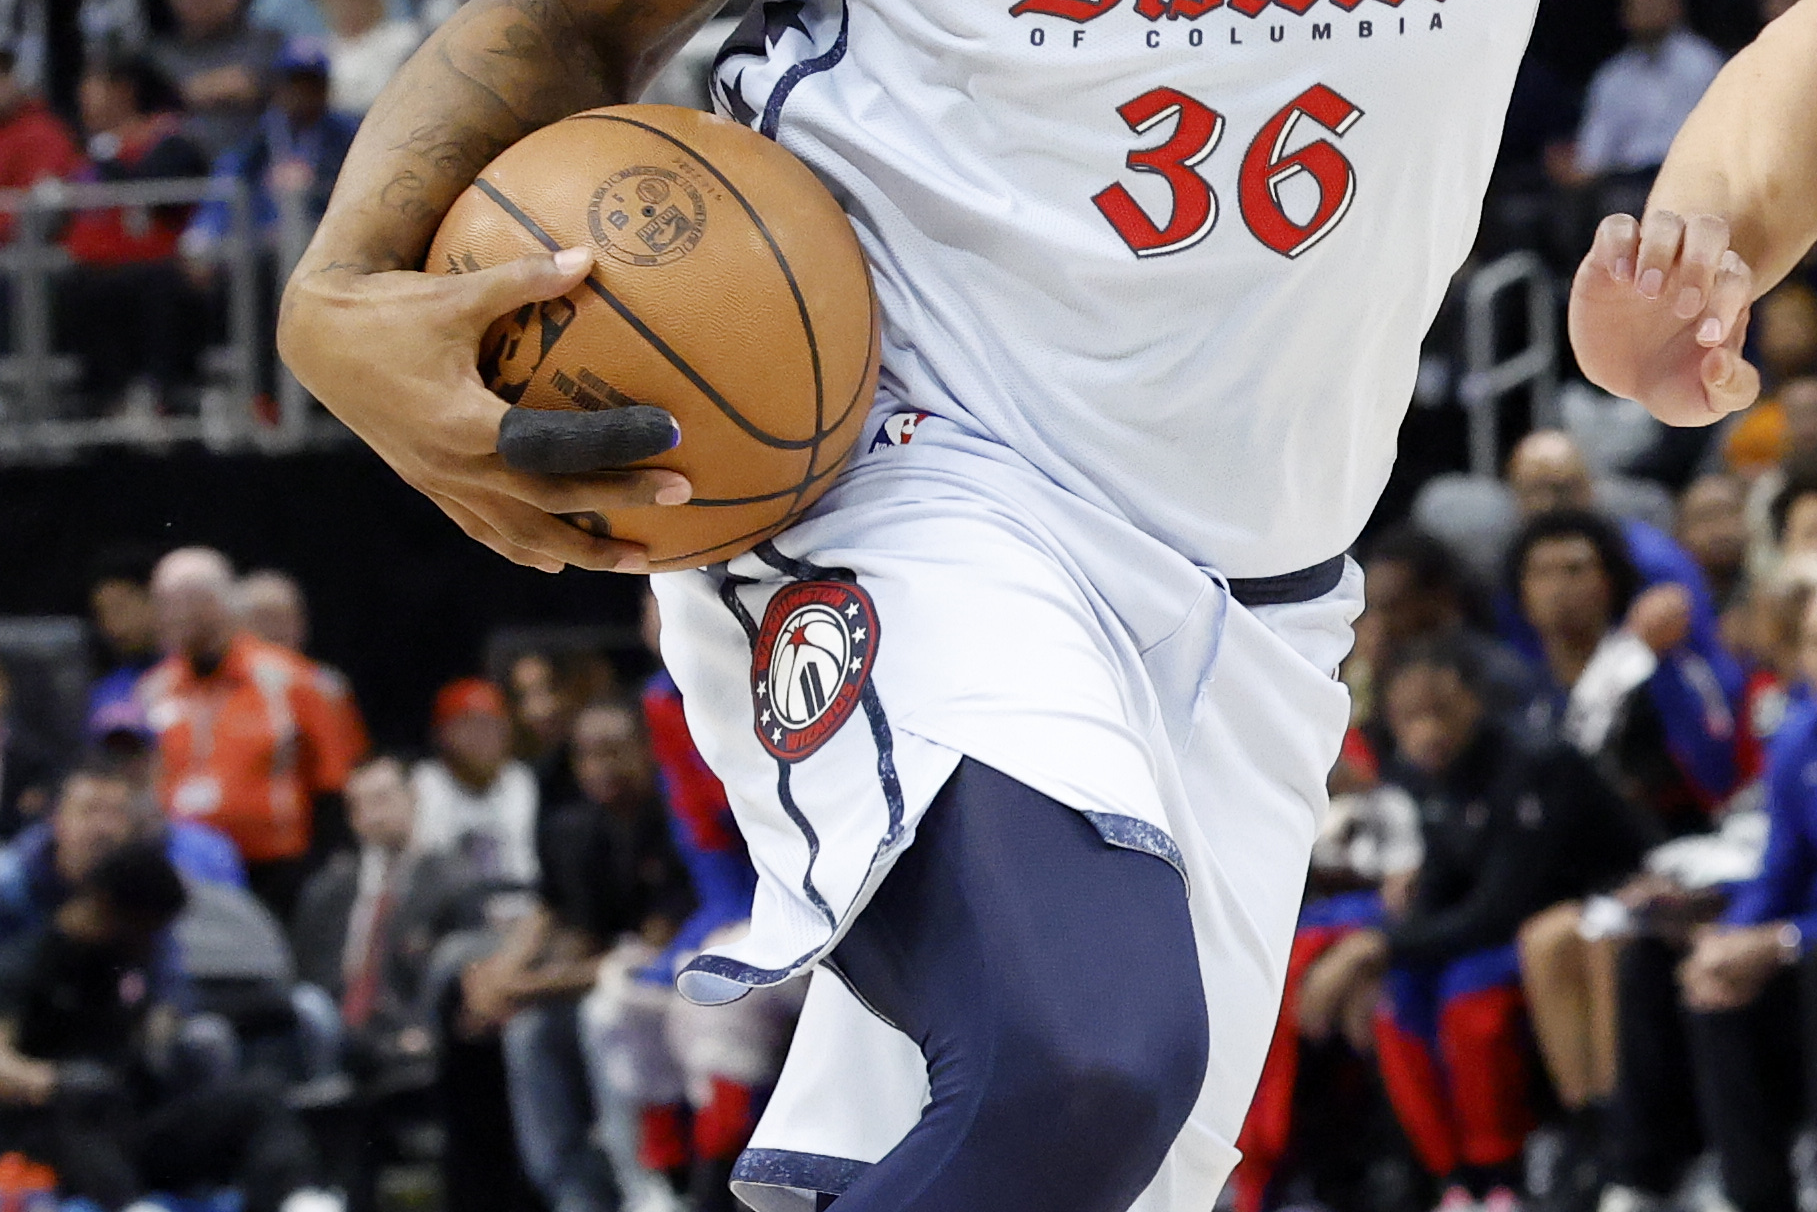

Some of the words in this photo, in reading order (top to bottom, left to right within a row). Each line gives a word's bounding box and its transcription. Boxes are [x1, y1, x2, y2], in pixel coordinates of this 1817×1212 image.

[1029, 27, 1087, 49] OF
[1145, 11, 1444, 49] COLUMBIA
[1090, 82, 1366, 260] 36
